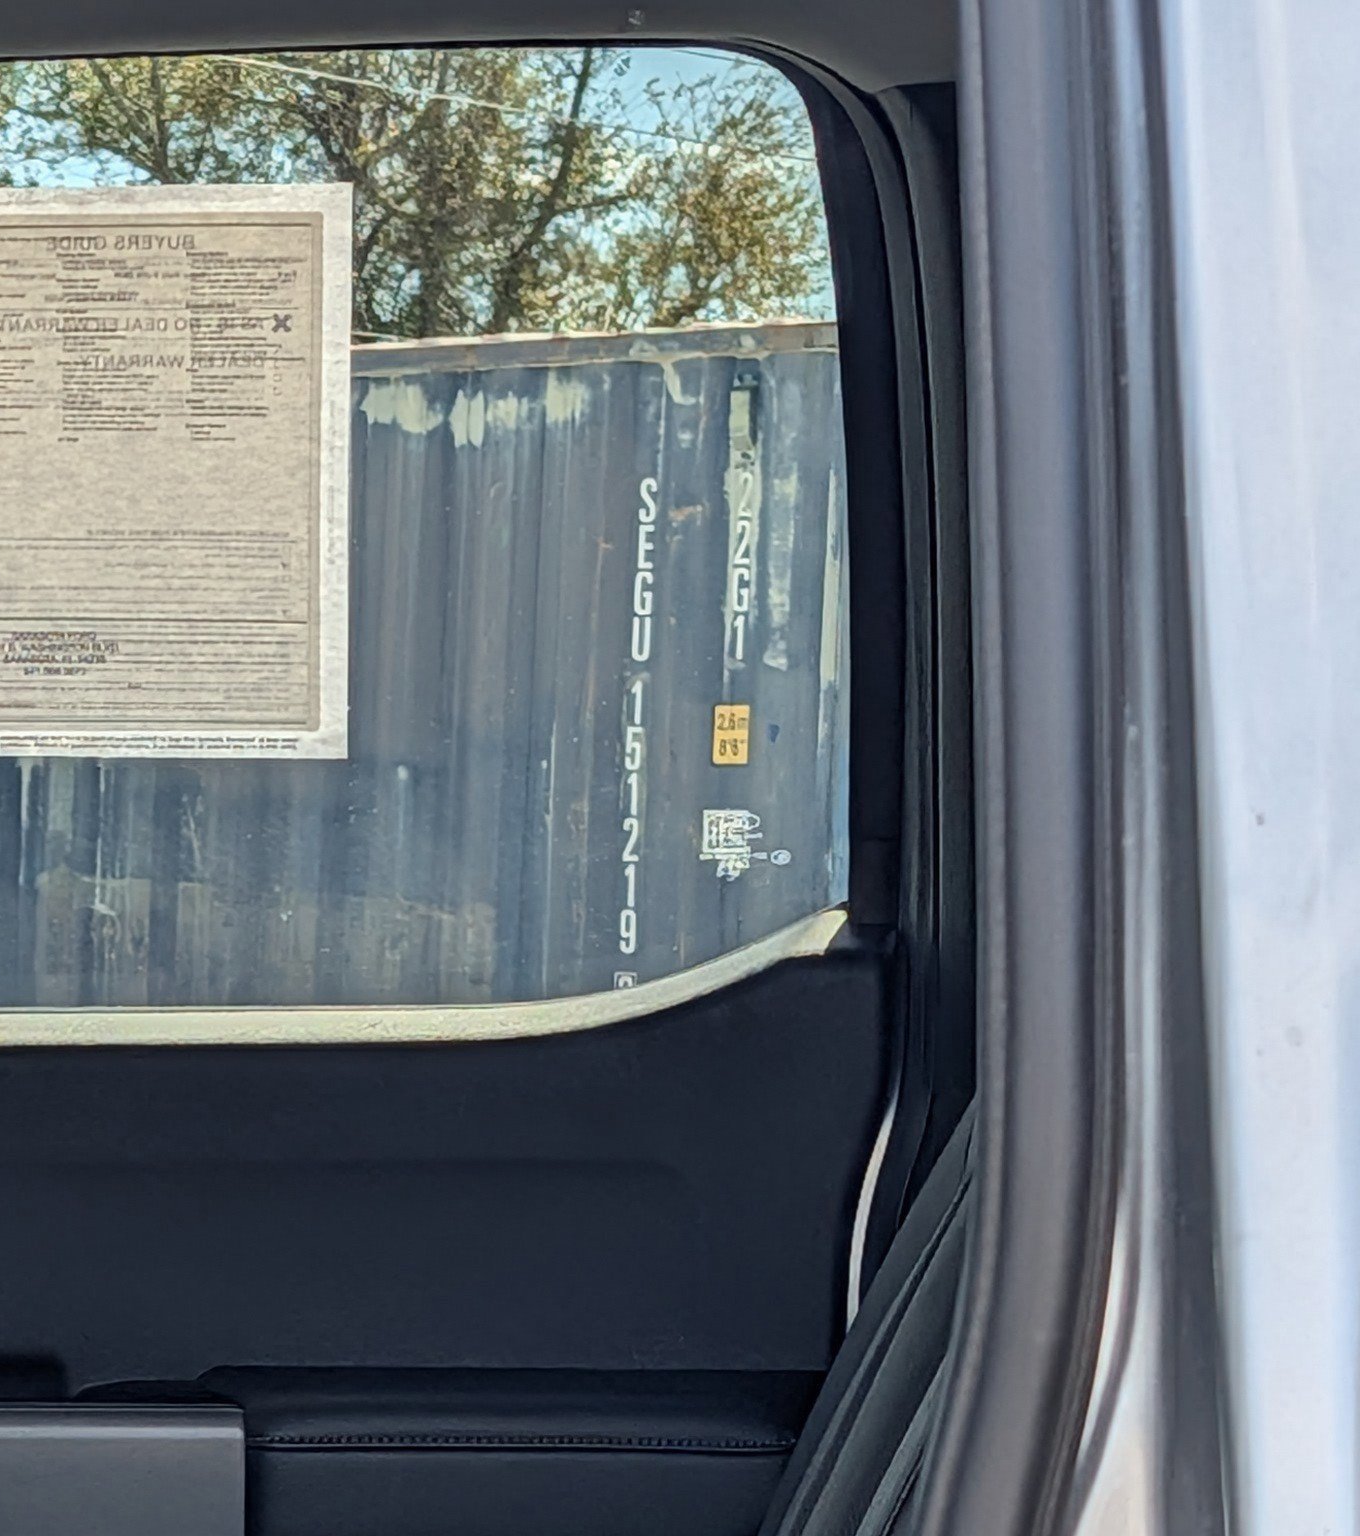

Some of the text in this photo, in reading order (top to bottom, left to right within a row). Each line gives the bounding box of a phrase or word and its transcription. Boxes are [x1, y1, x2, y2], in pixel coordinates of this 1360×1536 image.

[630, 476, 659, 663] SEGU
[730, 470, 755, 661] 22G1
[618, 681, 645, 955] 151219
